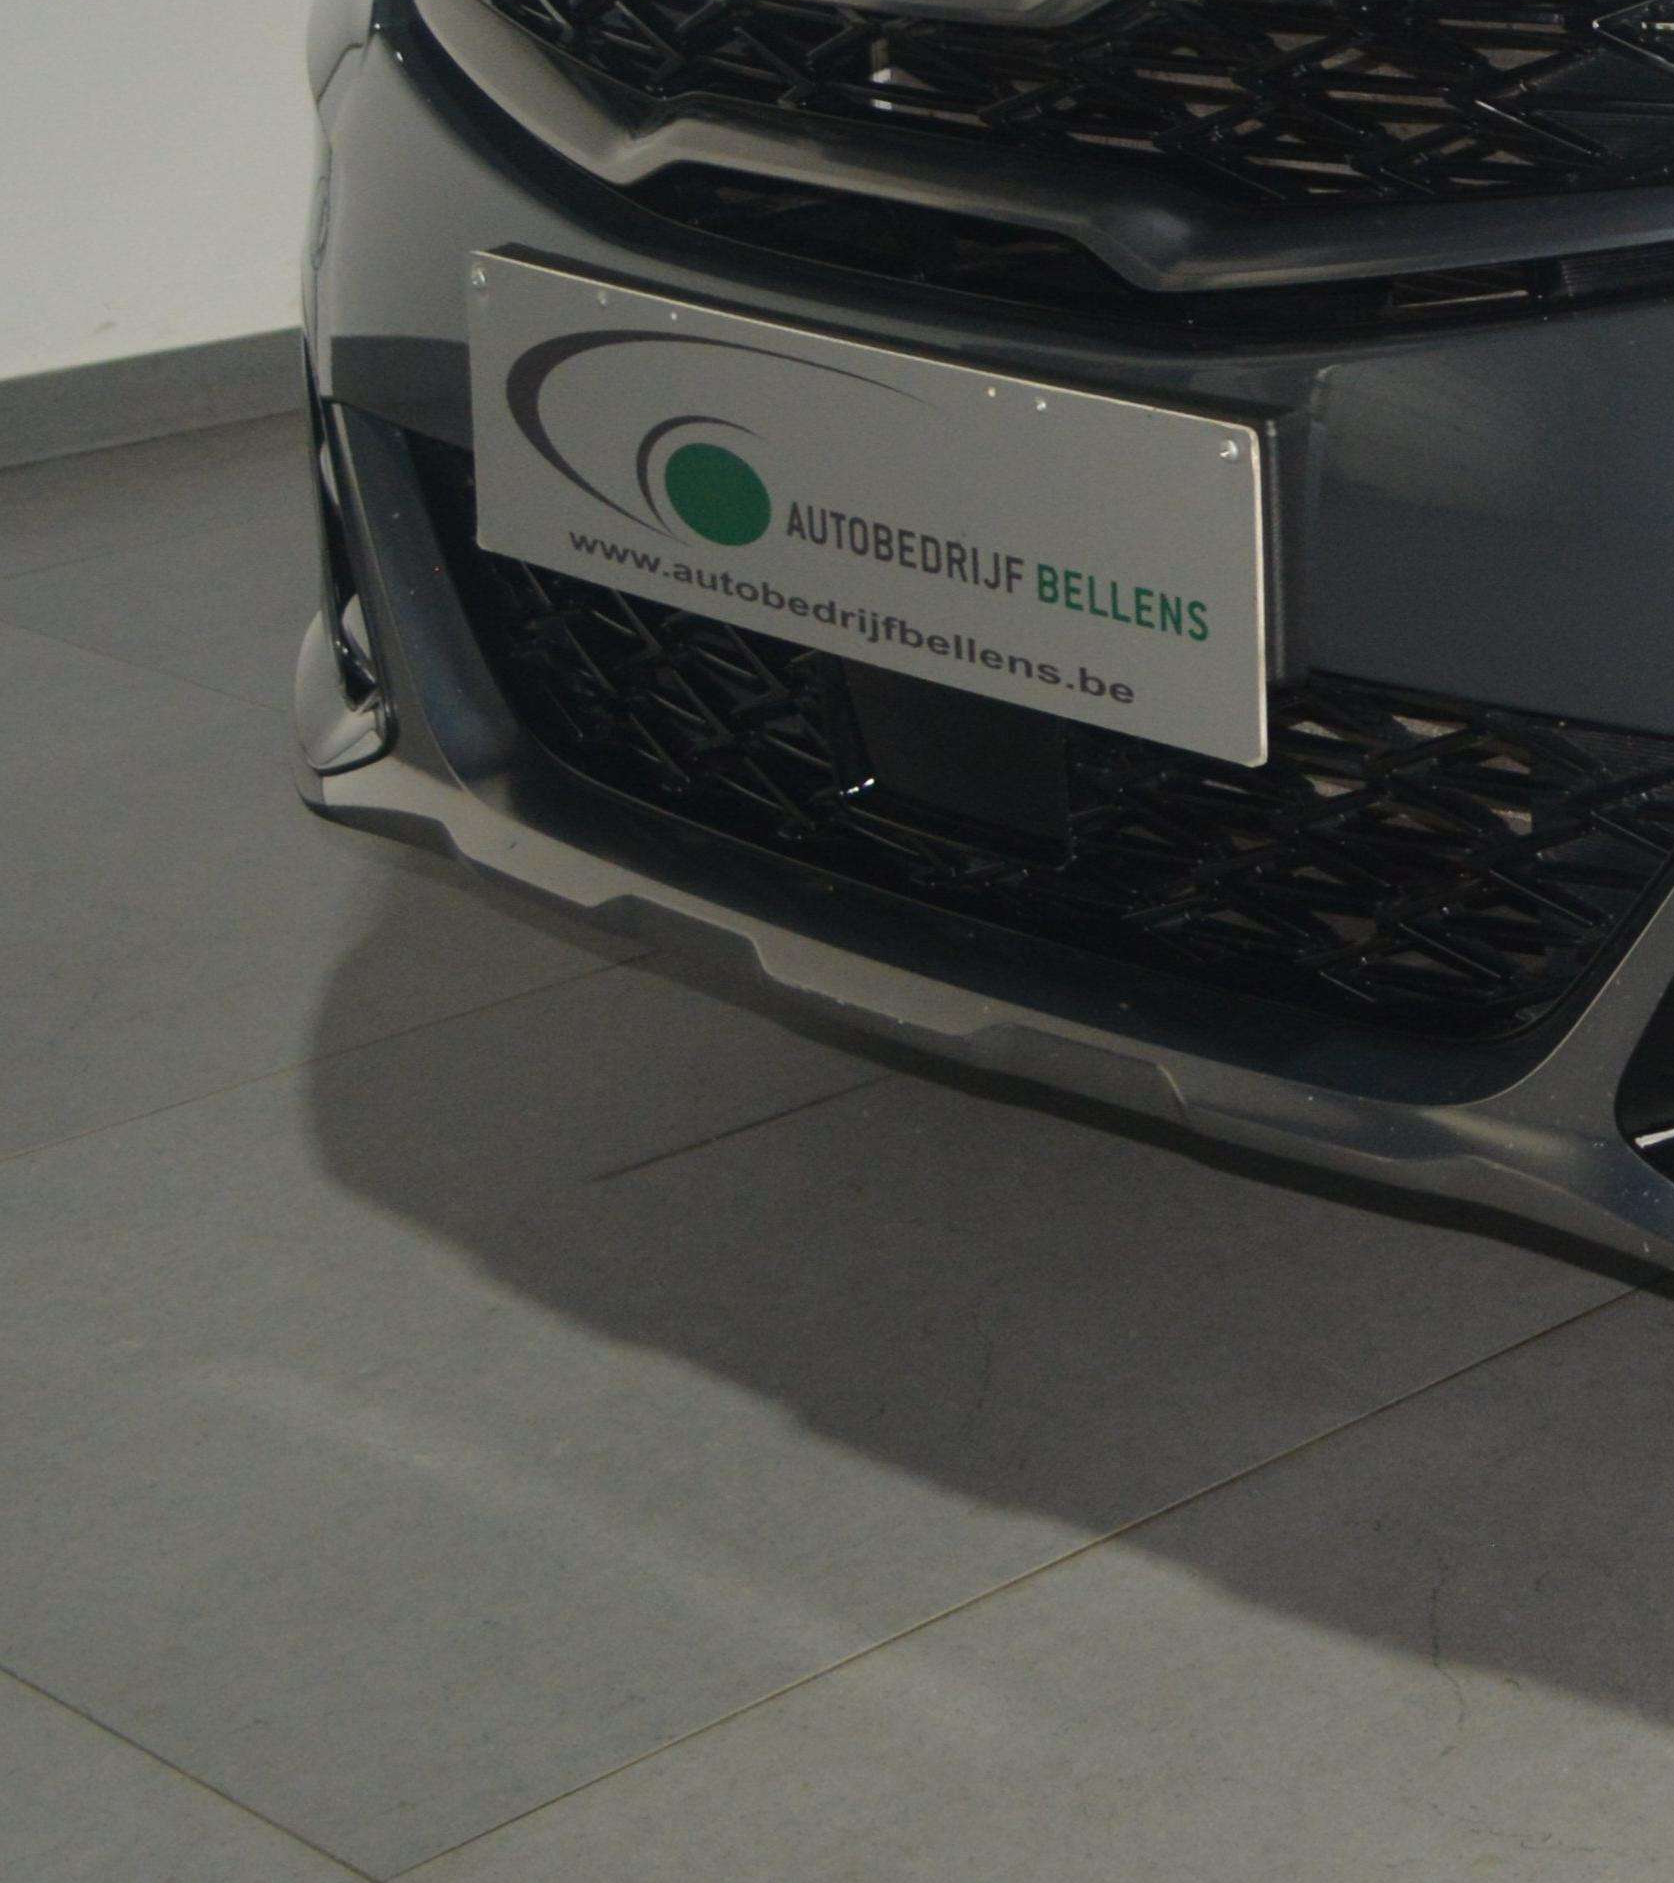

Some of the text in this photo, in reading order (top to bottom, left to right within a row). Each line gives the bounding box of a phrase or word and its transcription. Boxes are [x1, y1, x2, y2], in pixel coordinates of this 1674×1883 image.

[569, 530, 1136, 706] www.autobedrijfbellens.be
[787, 500, 1210, 642] AUTOBEDRIJF BELLENS
